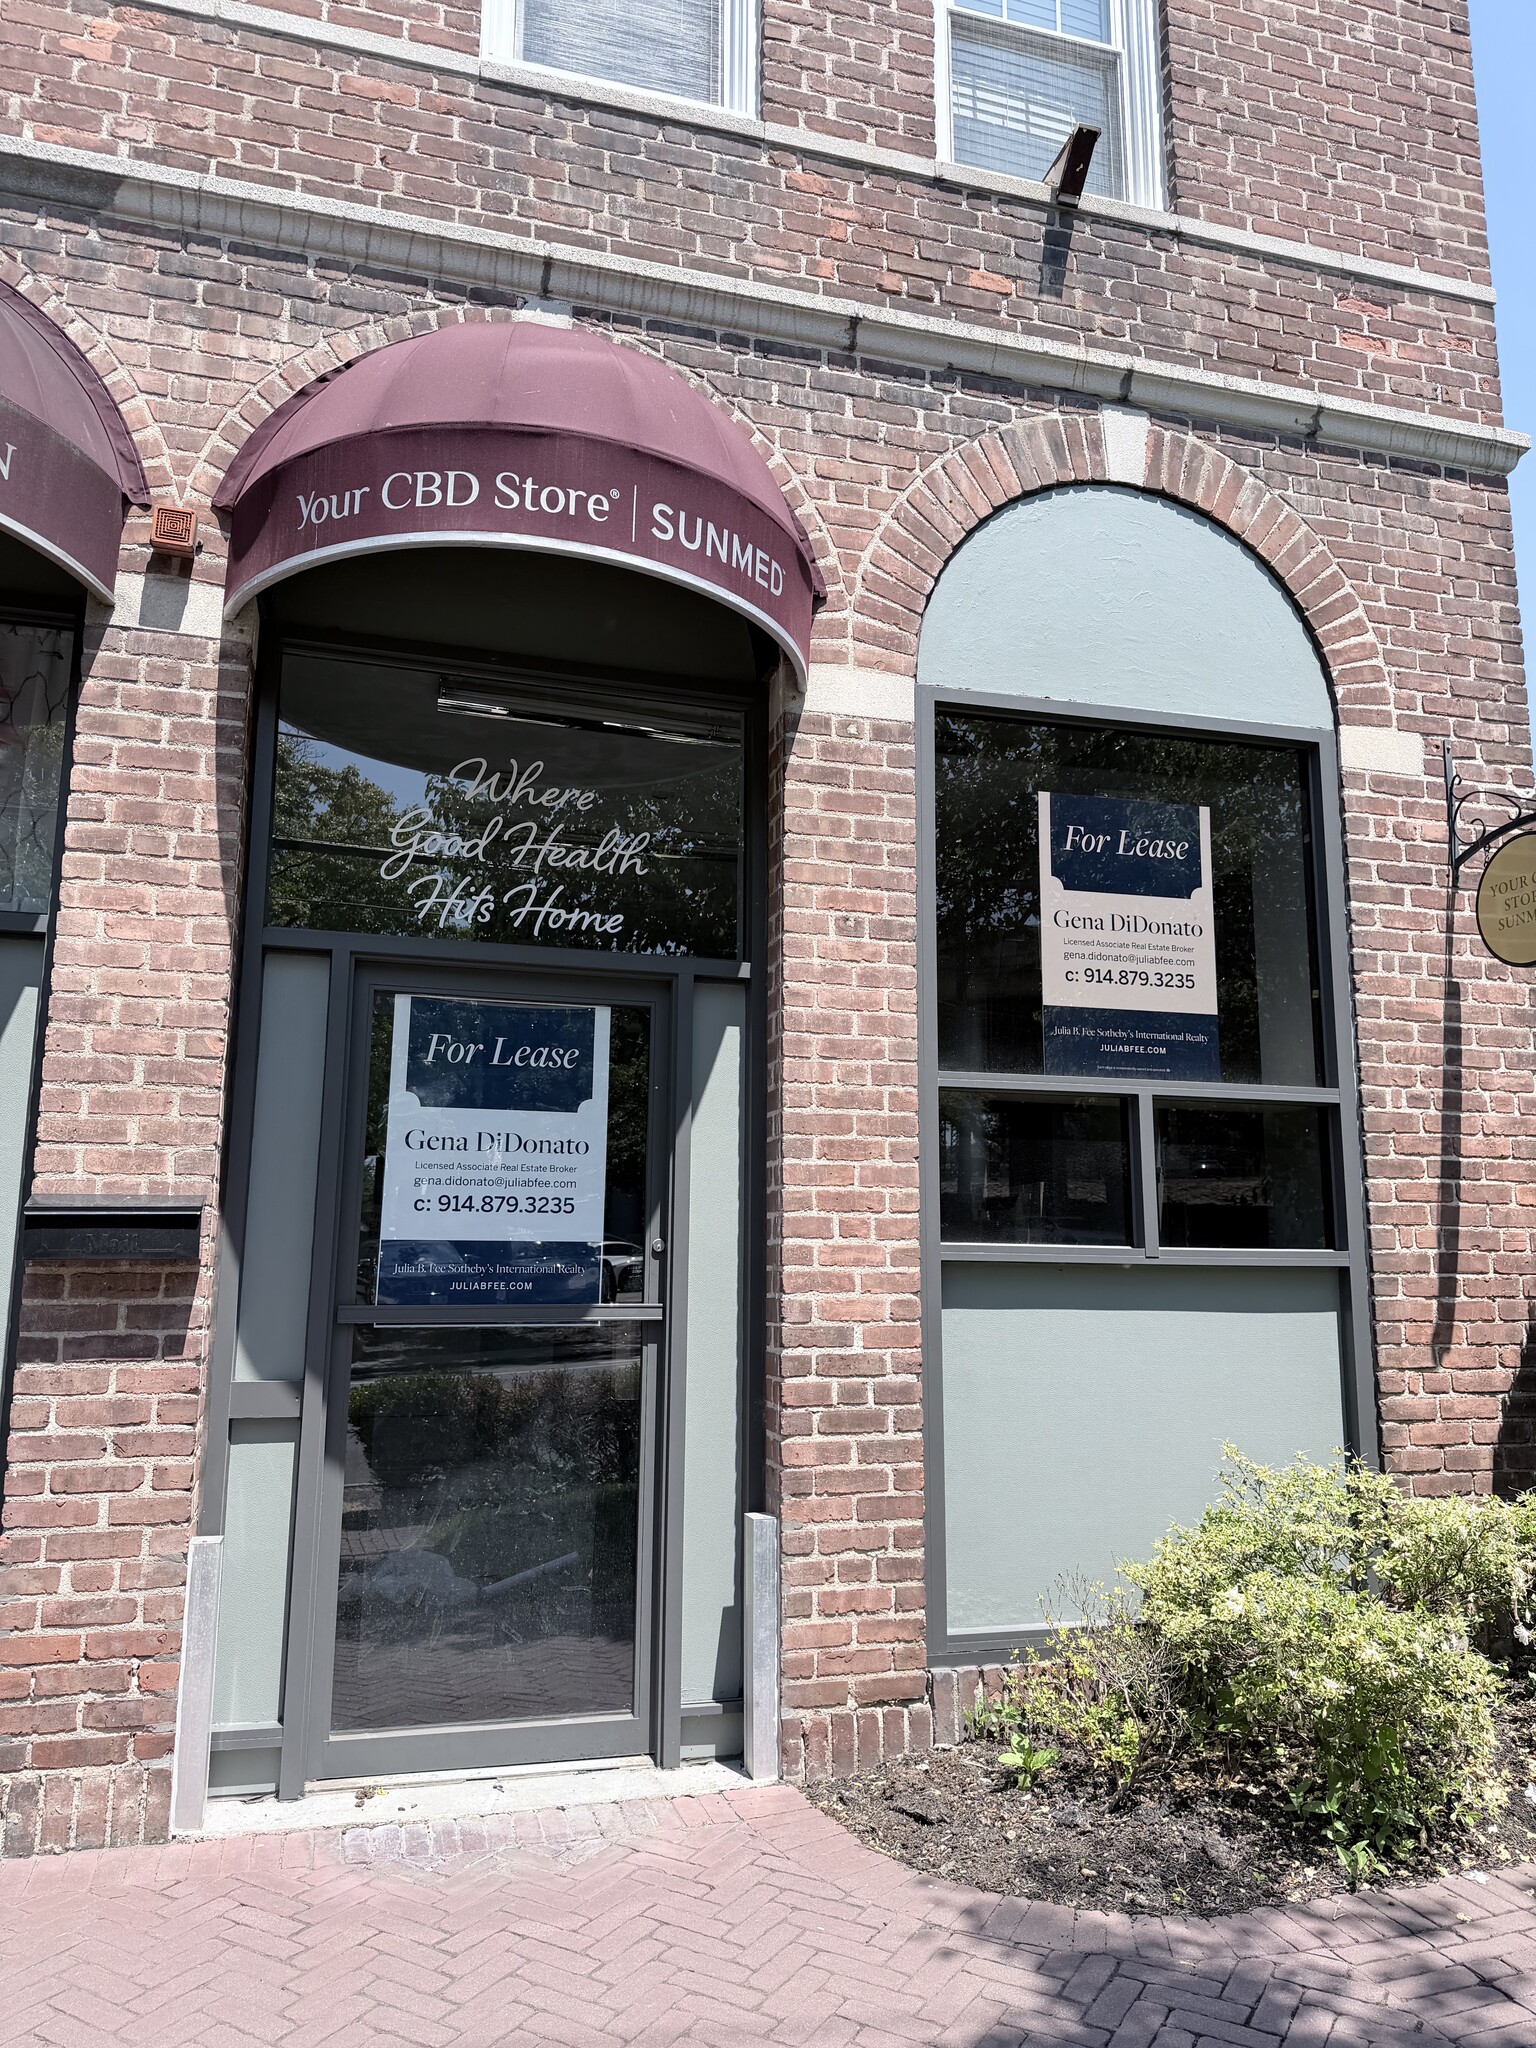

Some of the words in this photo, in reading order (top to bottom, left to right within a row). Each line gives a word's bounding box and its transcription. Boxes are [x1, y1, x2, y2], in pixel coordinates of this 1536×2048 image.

[381, 471, 480, 507] CBD
[449, 757, 596, 811] Where
[380, 807, 503, 880] Good
[504, 821, 652, 875] Health
[1064, 825, 1111, 854] For
[1116, 830, 1189, 860] Lease
[1490, 875, 1529, 898] YOUR
[503, 884, 625, 937] Home
[1053, 909, 1105, 931] Gena
[1110, 914, 1203, 938] DiDonato
[1063, 938, 1095, 947] Licensed
[1096, 940, 1130, 950] Associate
[1148, 943, 1170, 952] Estate
[1171, 945, 1195, 953] Broker
[1063, 950, 1196, 967] gena.didonato@juliabfee.com
[1065, 970, 1079, 982] c:
[1084, 967, 1195, 989] 914.879.3235
[1053, 1026, 1071, 1036] Julia
[1072, 1027, 1081, 1036] B.
[1135, 1030, 1184, 1041] International
[1185, 1033, 1209, 1045] Realty
[423, 1033, 484, 1064] For
[489, 1036, 580, 1069] Lease
[1100, 1044, 1167, 1054] JULIABFEE.COM
[404, 1129, 468, 1152] Gena
[476, 1131, 590, 1156] DiDonato
[415, 1161, 454, 1170] Licensed
[456, 1162, 499, 1172] Associate
[500, 1164, 519, 1172] Real
[520, 1165, 548, 1173] Estate
[549, 1165, 578, 1173] Broker
[413, 1176, 577, 1190] gena.didonato@juliabfee.com
[413, 1198, 431, 1212] c:
[438, 1195, 575, 1215] 914.879.3235
[393, 1263, 415, 1275] Julia
[417, 1264, 427, 1274] B.
[496, 1264, 556, 1275] International
[557, 1265, 586, 1277] Realty
[449, 1281, 533, 1291] JULIABFEE.COM
